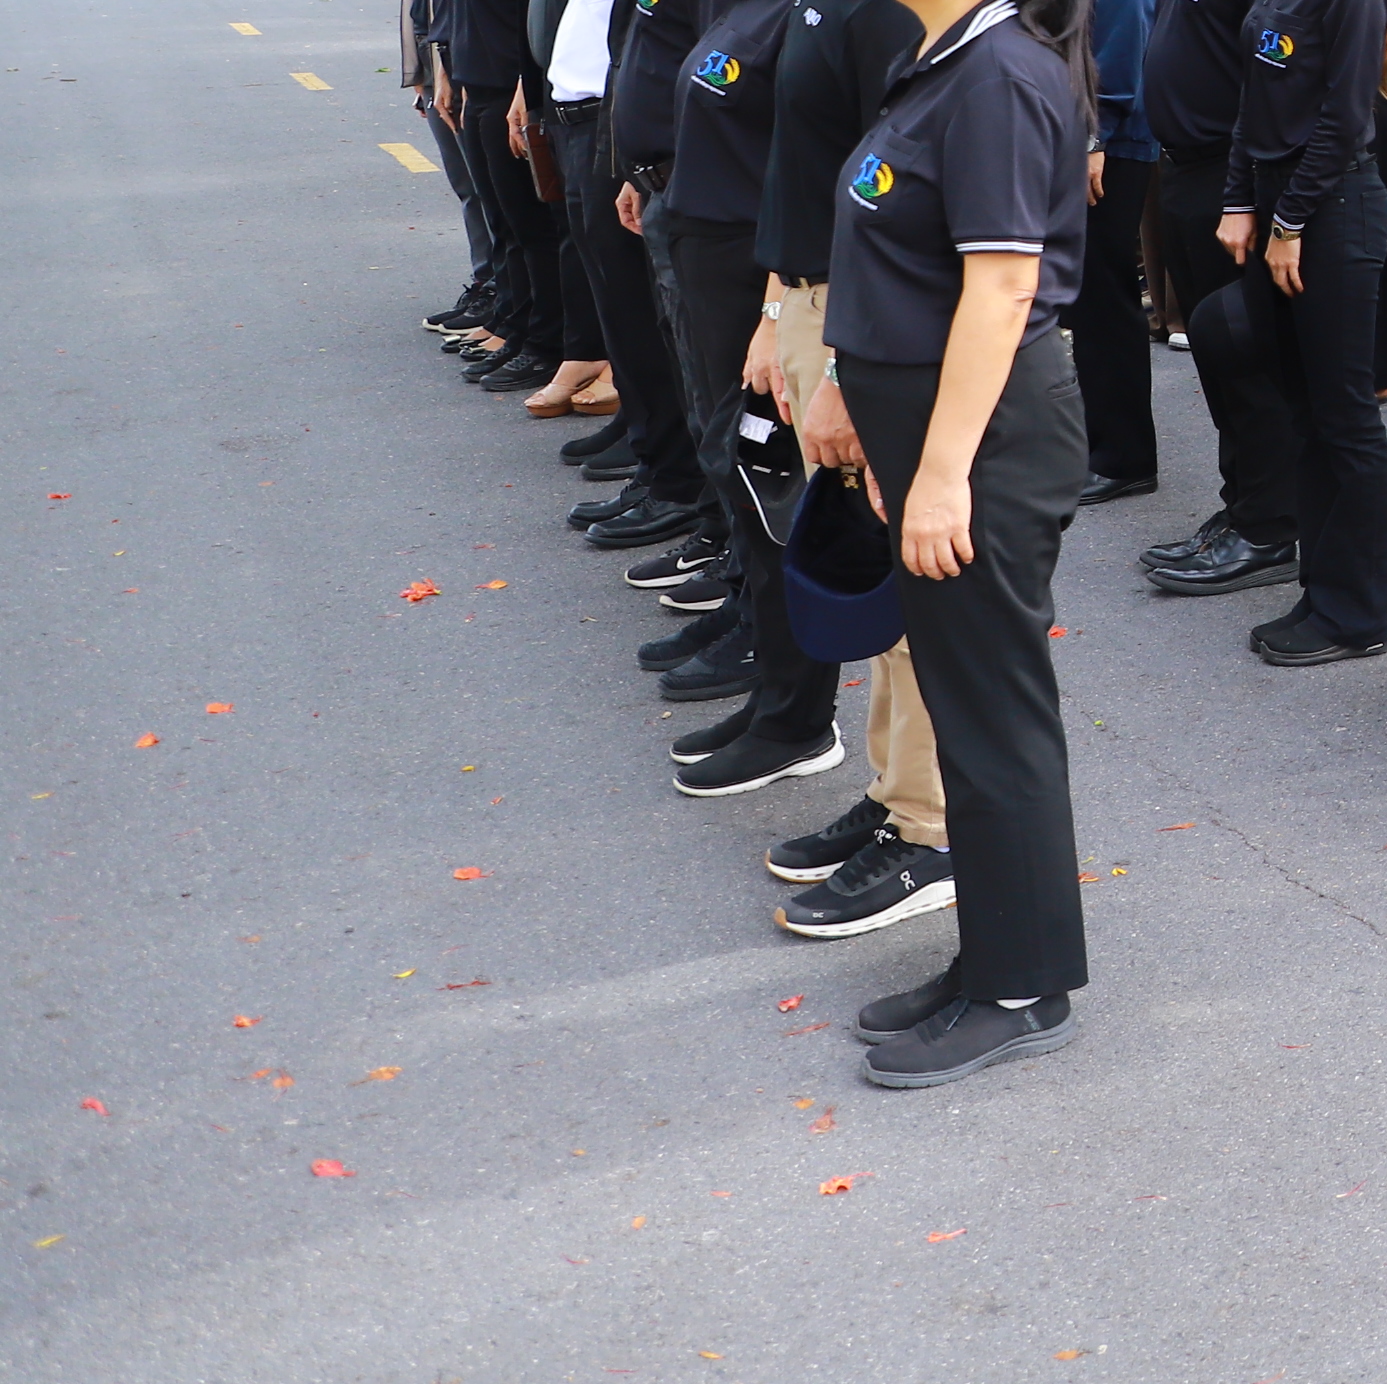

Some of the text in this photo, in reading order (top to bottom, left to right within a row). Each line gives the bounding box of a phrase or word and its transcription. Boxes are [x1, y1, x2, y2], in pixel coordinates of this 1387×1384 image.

[1258, 28, 1279, 53] 51
[697, 50, 729, 75] 51
[853, 153, 881, 185] 51
